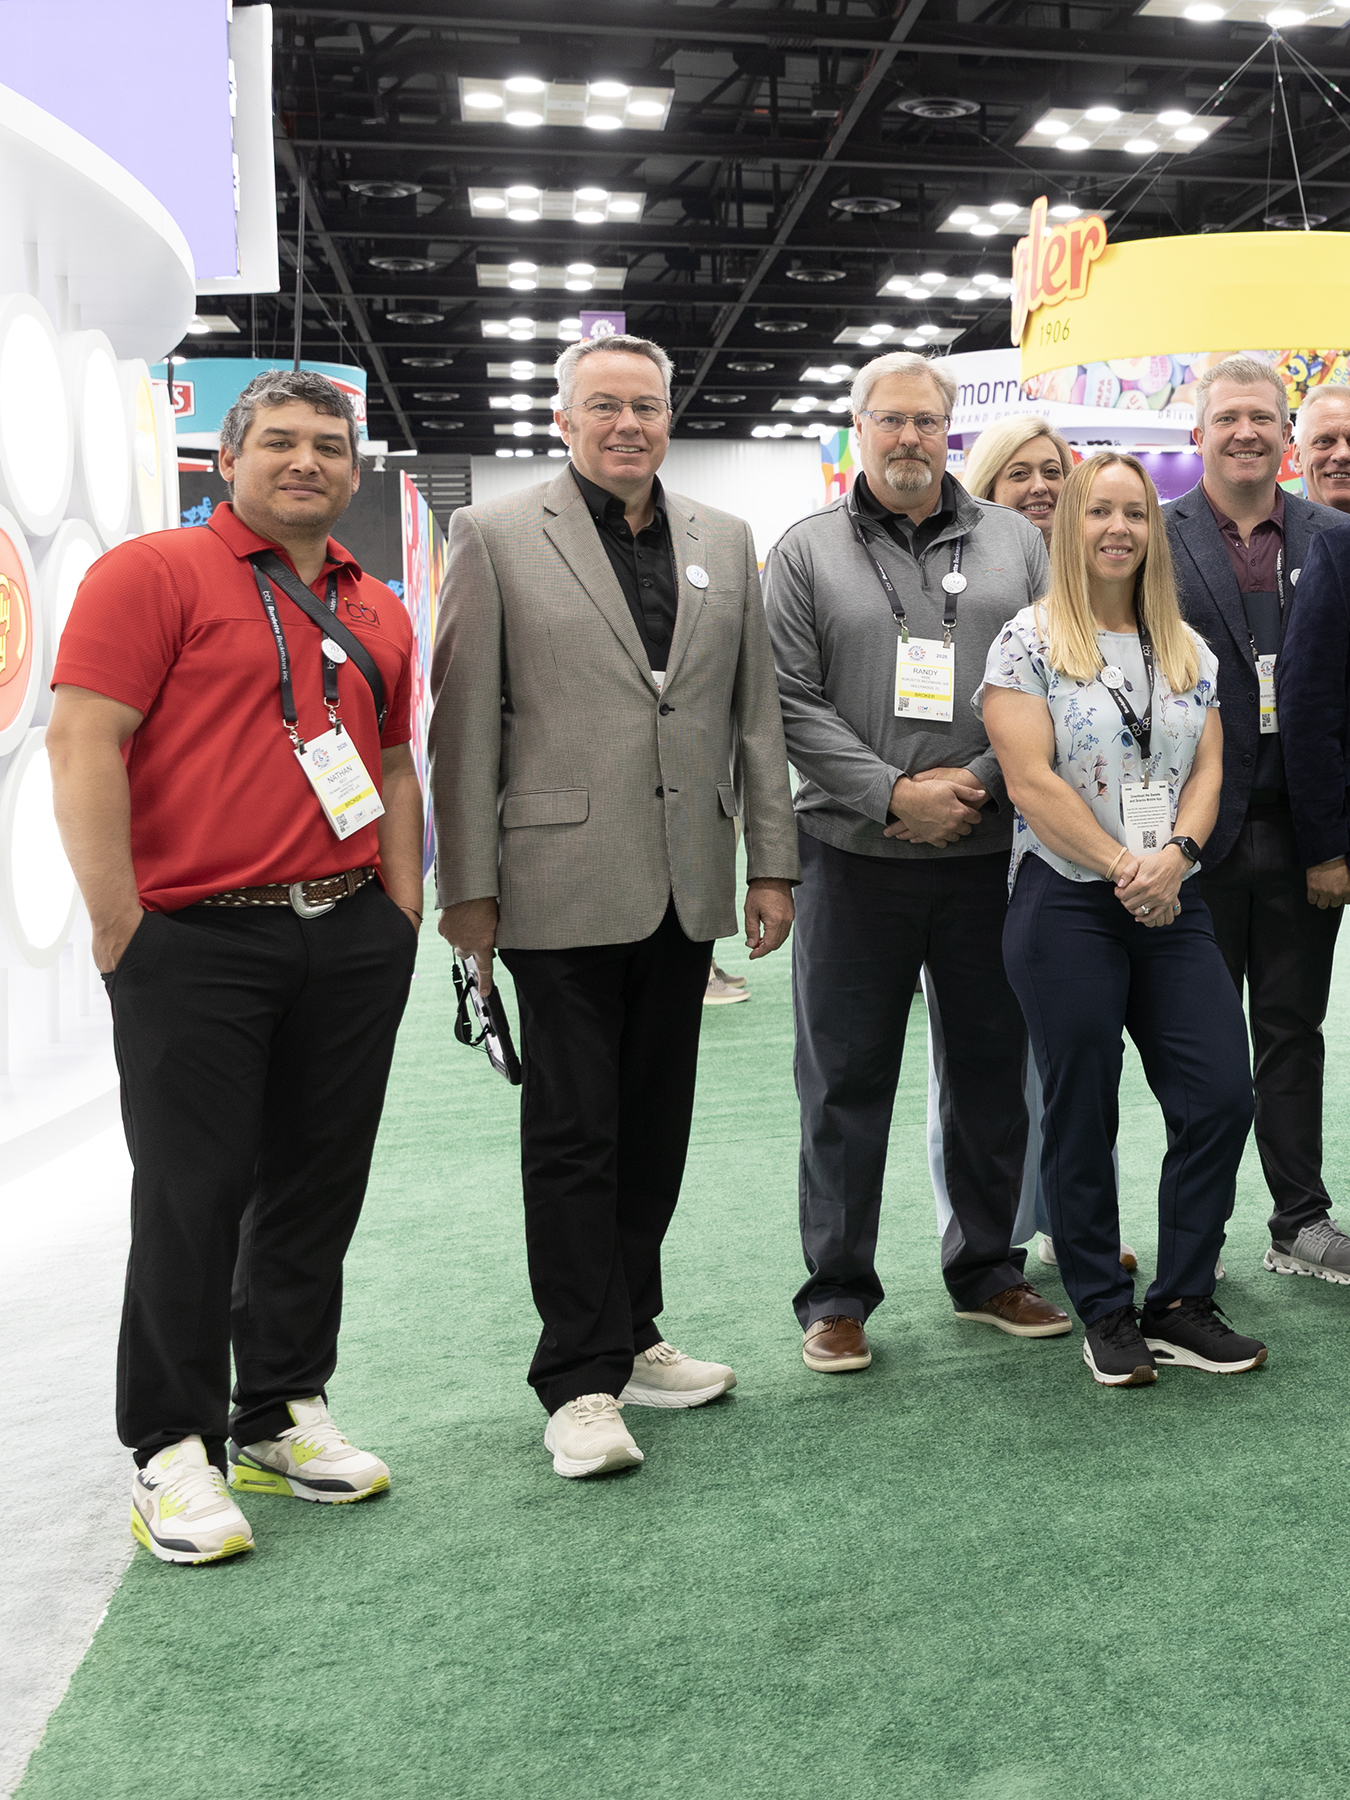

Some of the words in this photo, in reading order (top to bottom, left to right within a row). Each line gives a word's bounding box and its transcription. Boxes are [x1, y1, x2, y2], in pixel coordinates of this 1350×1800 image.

[1040, 317, 1071, 347] 1906
[957, 380, 1039, 408] morri
[267, 606, 280, 634] Burdette
[276, 635, 288, 670] Beckmann
[913, 667, 938, 676] RANDY
[327, 765, 353, 784] NATHAN
